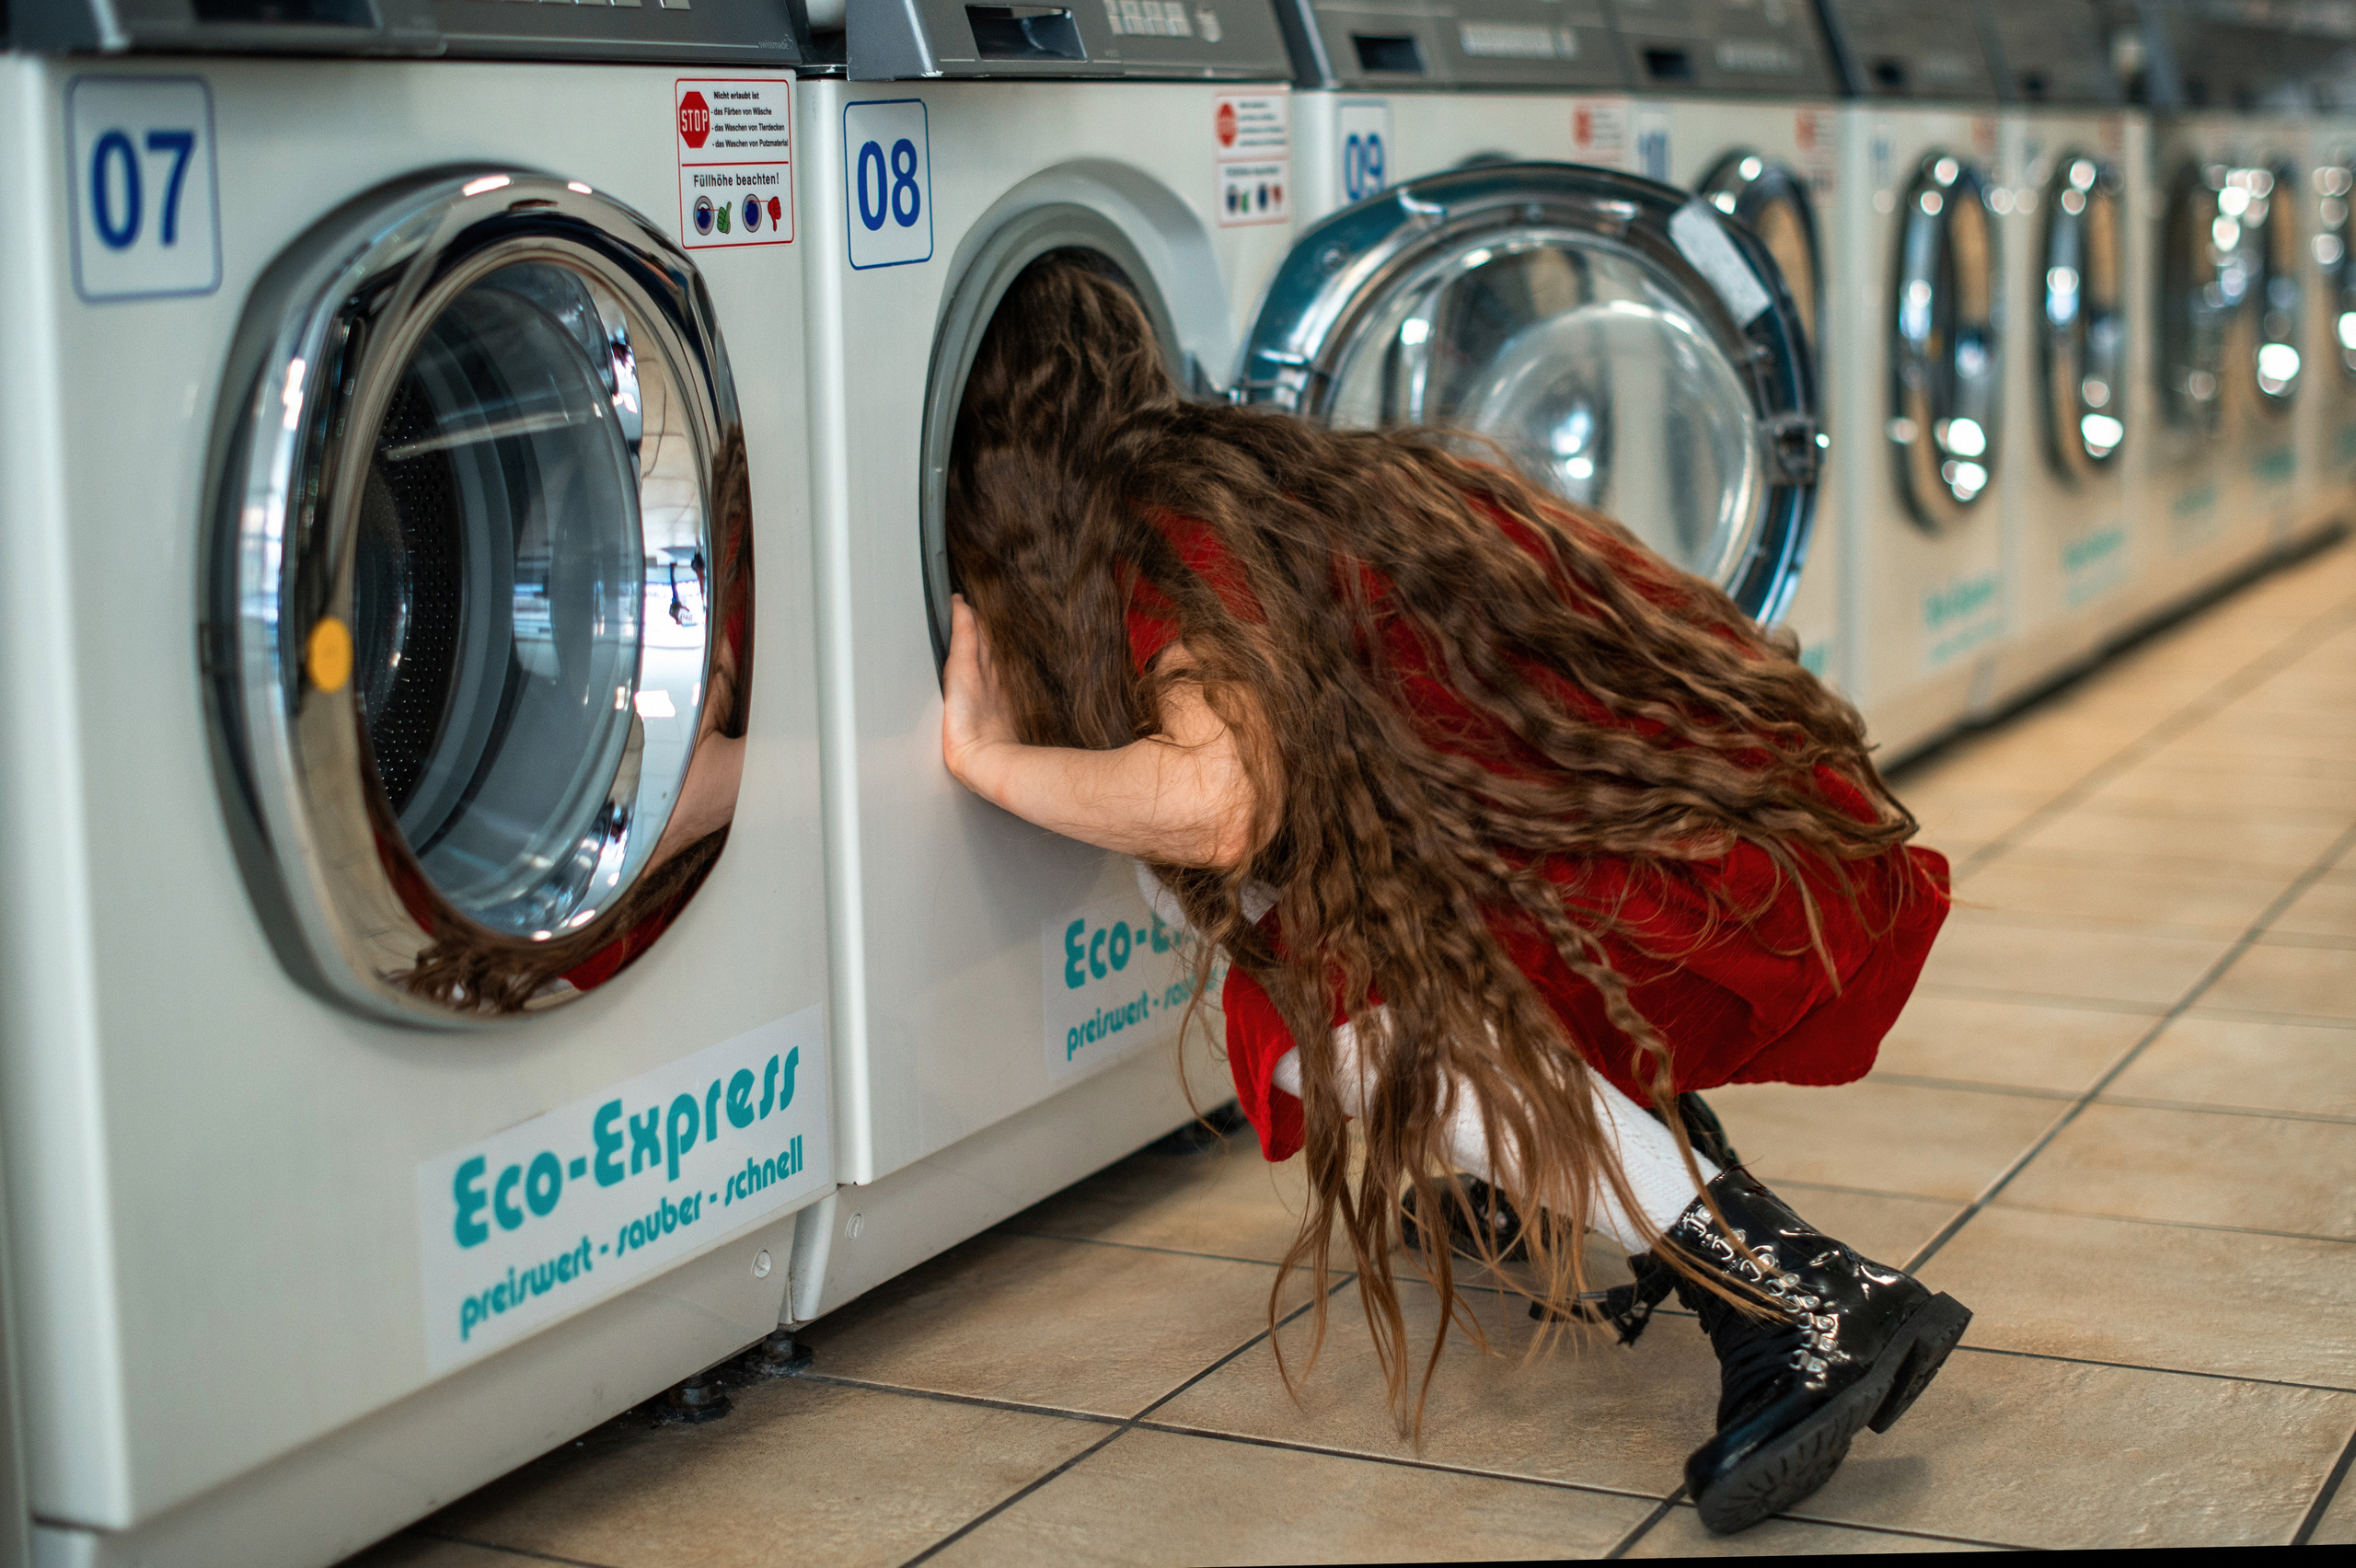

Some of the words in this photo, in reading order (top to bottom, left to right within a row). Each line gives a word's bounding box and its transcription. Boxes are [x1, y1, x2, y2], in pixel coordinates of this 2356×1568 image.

[758, 39, 789, 50] swissmade
[713, 91, 730, 99] Nicht
[730, 91, 751, 99] erlaubt
[752, 91, 760, 99] ist
[681, 109, 709, 132] STOP
[713, 108, 723, 116] das
[723, 108, 742, 116] Färben
[752, 107, 772, 116] Wäsche
[714, 123, 724, 132] das
[724, 123, 747, 132] Waschen
[758, 122, 785, 132] Tierdecken
[715, 140, 724, 148] das
[725, 139, 748, 147] Waschen
[758, 139, 789, 147] Putzmaterial
[89, 129, 194, 249] 07
[694, 173, 733, 188] Füllhöhe
[735, 172, 780, 186] beachten!
[857, 138, 921, 232] 08
[1067, 990, 1149, 1062] preiswert
[454, 1045, 799, 1251] Eco-Express
[460, 1235, 594, 1342] preiswert
[616, 1190, 702, 1258] sauber
[724, 1134, 803, 1207] schnell
